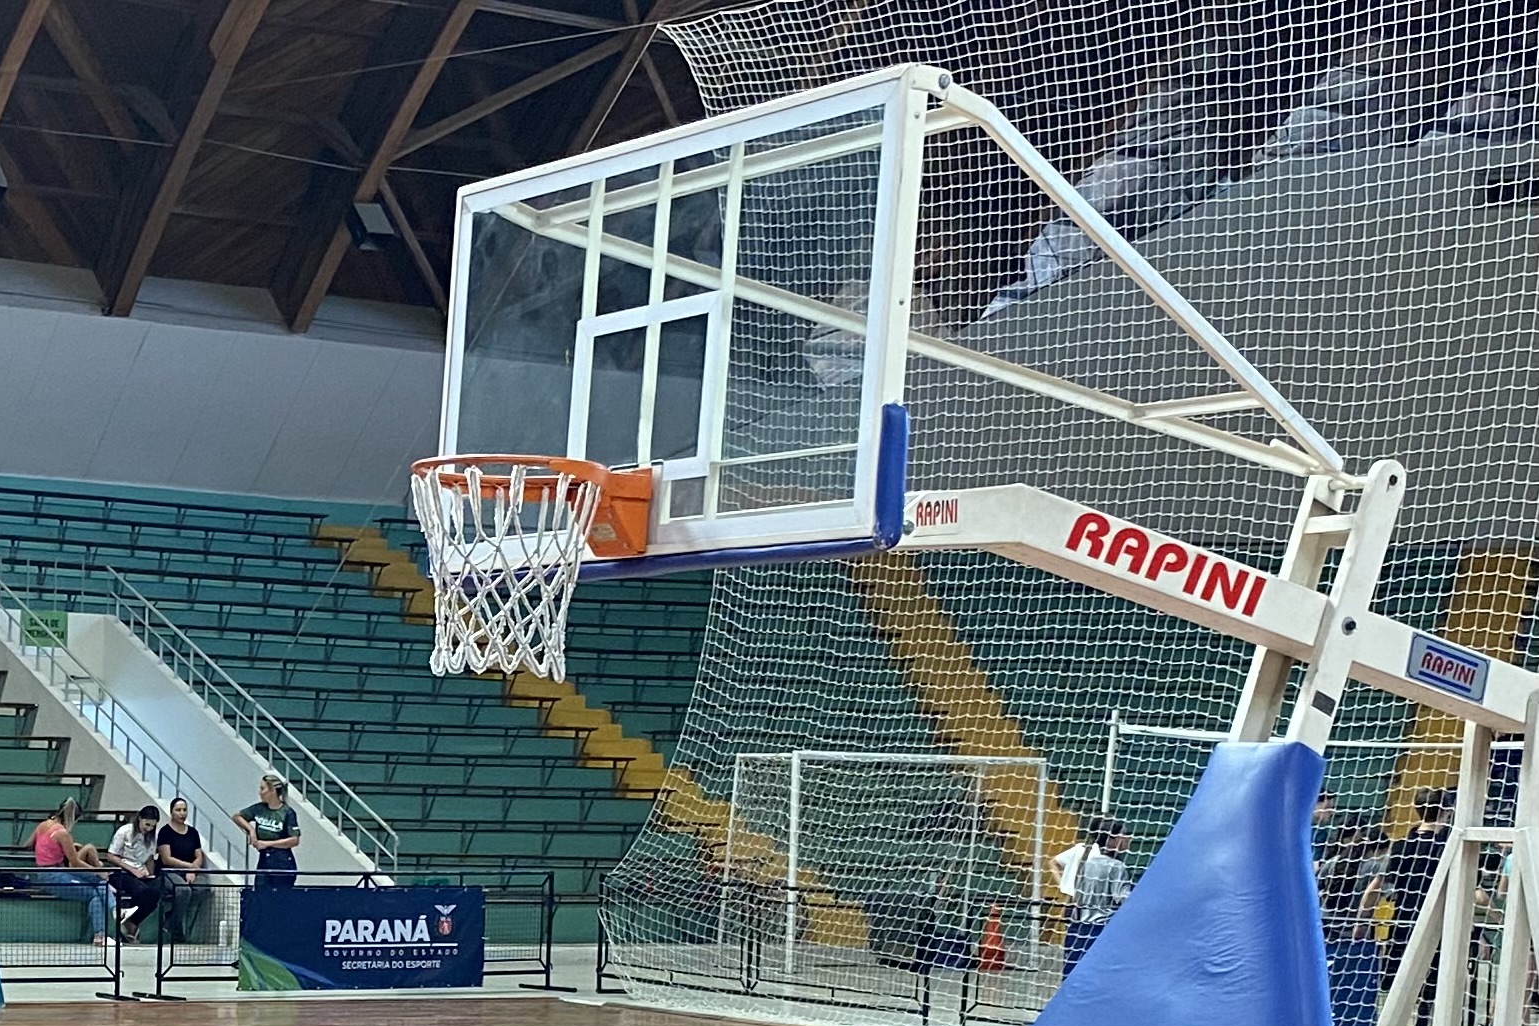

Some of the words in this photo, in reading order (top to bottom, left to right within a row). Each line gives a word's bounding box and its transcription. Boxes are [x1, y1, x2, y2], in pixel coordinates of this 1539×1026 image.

[915, 498, 959, 528] RAPINI
[1065, 512, 1267, 617] RAPINI
[1421, 652, 1477, 686] RAPINI
[324, 915, 431, 942] PARANÁ
[324, 949, 382, 957] GOVERNO
[412, 948, 459, 956] ESTADO
[341, 960, 391, 970] SECRETARIA
[391, 960, 404, 969] DO
[405, 960, 442, 969] ESPORTE
